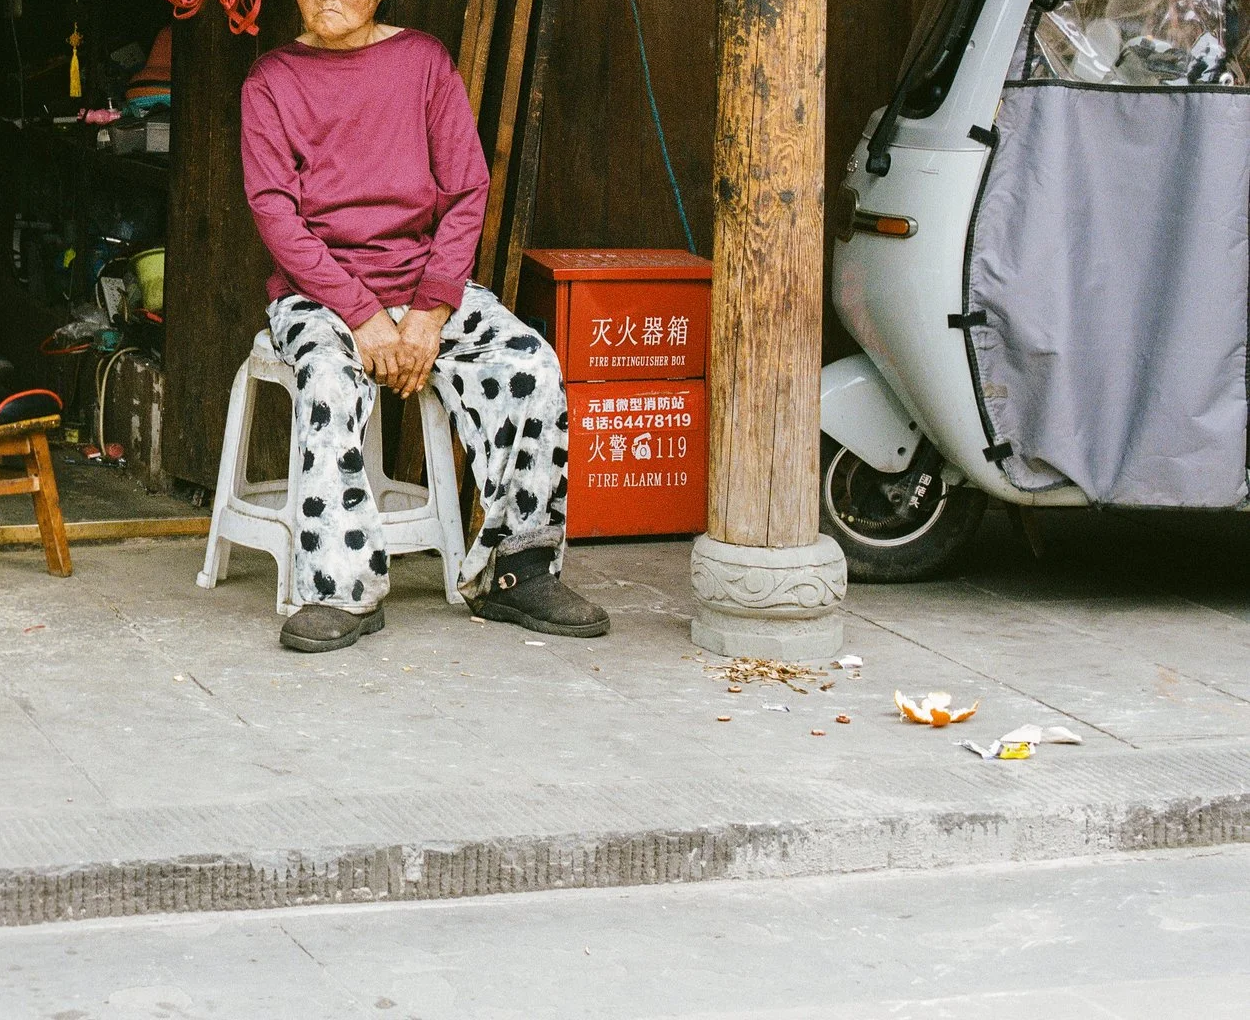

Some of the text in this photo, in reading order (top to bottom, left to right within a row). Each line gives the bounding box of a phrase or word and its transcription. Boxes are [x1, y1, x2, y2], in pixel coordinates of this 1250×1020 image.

[589, 315, 689, 347] 灭火器箱
[589, 355, 686, 367] FIRE EXTINGUISHER BOX
[588, 396, 685, 413] 元通微型消防站
[587, 434, 687, 463] 火警 119
[587, 471, 687, 488] FIRE ALARM 119
